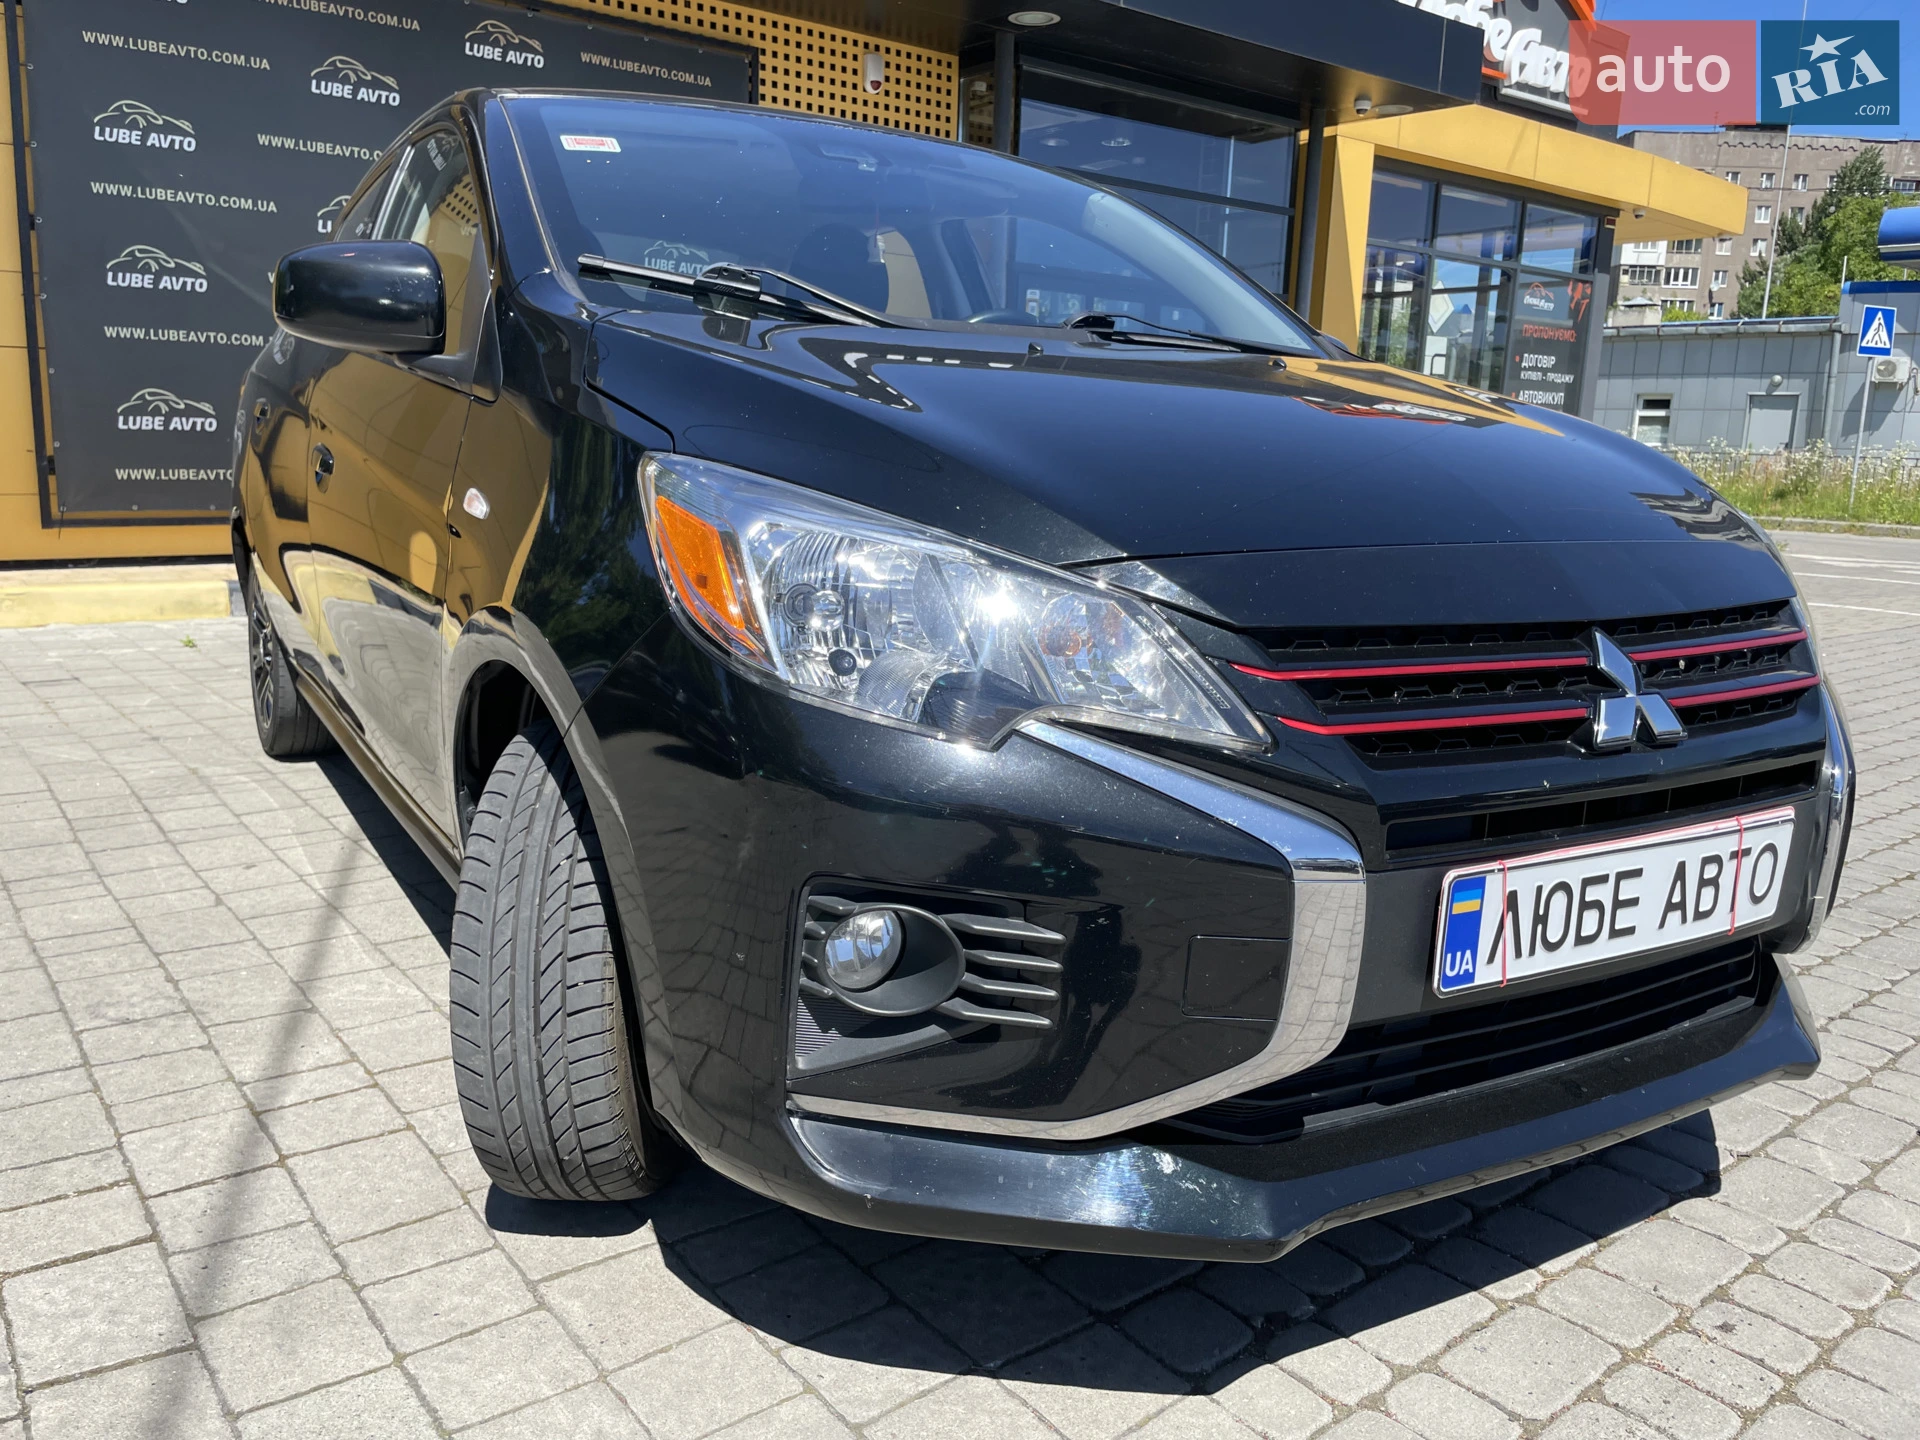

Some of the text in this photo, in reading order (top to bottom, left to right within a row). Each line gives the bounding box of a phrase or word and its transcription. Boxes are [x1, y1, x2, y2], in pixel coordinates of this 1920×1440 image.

[257, 0, 421, 31] W.LUBEAVTO.COM.UA
[82, 30, 271, 71] WWW.LUBEAVTO.COM.UA
[465, 42, 545, 69] LUBE AVTO
[580, 51, 712, 87] WWW.LUBEAVTO.COM.UA
[311, 79, 401, 107] LUBE AVTO
[94, 126, 196, 153] LUBE AVTO
[91, 181, 278, 214] WWW.LUBEAVTO.COM.UA
[644, 257, 676, 273] LUBE
[106, 271, 208, 293] LUBE AVTO
[104, 325, 273, 347] WWW.LUBEAVTO.COM.
[1521, 353, 1556, 368] ДОГОВІР
[1518, 389, 1564, 405] АВТОВИКУП
[117, 416, 217, 432] LUBE AVTO
[1486, 841, 1779, 965] ЛЮБЕ АВТО
[1446, 953, 1474, 976] UA
